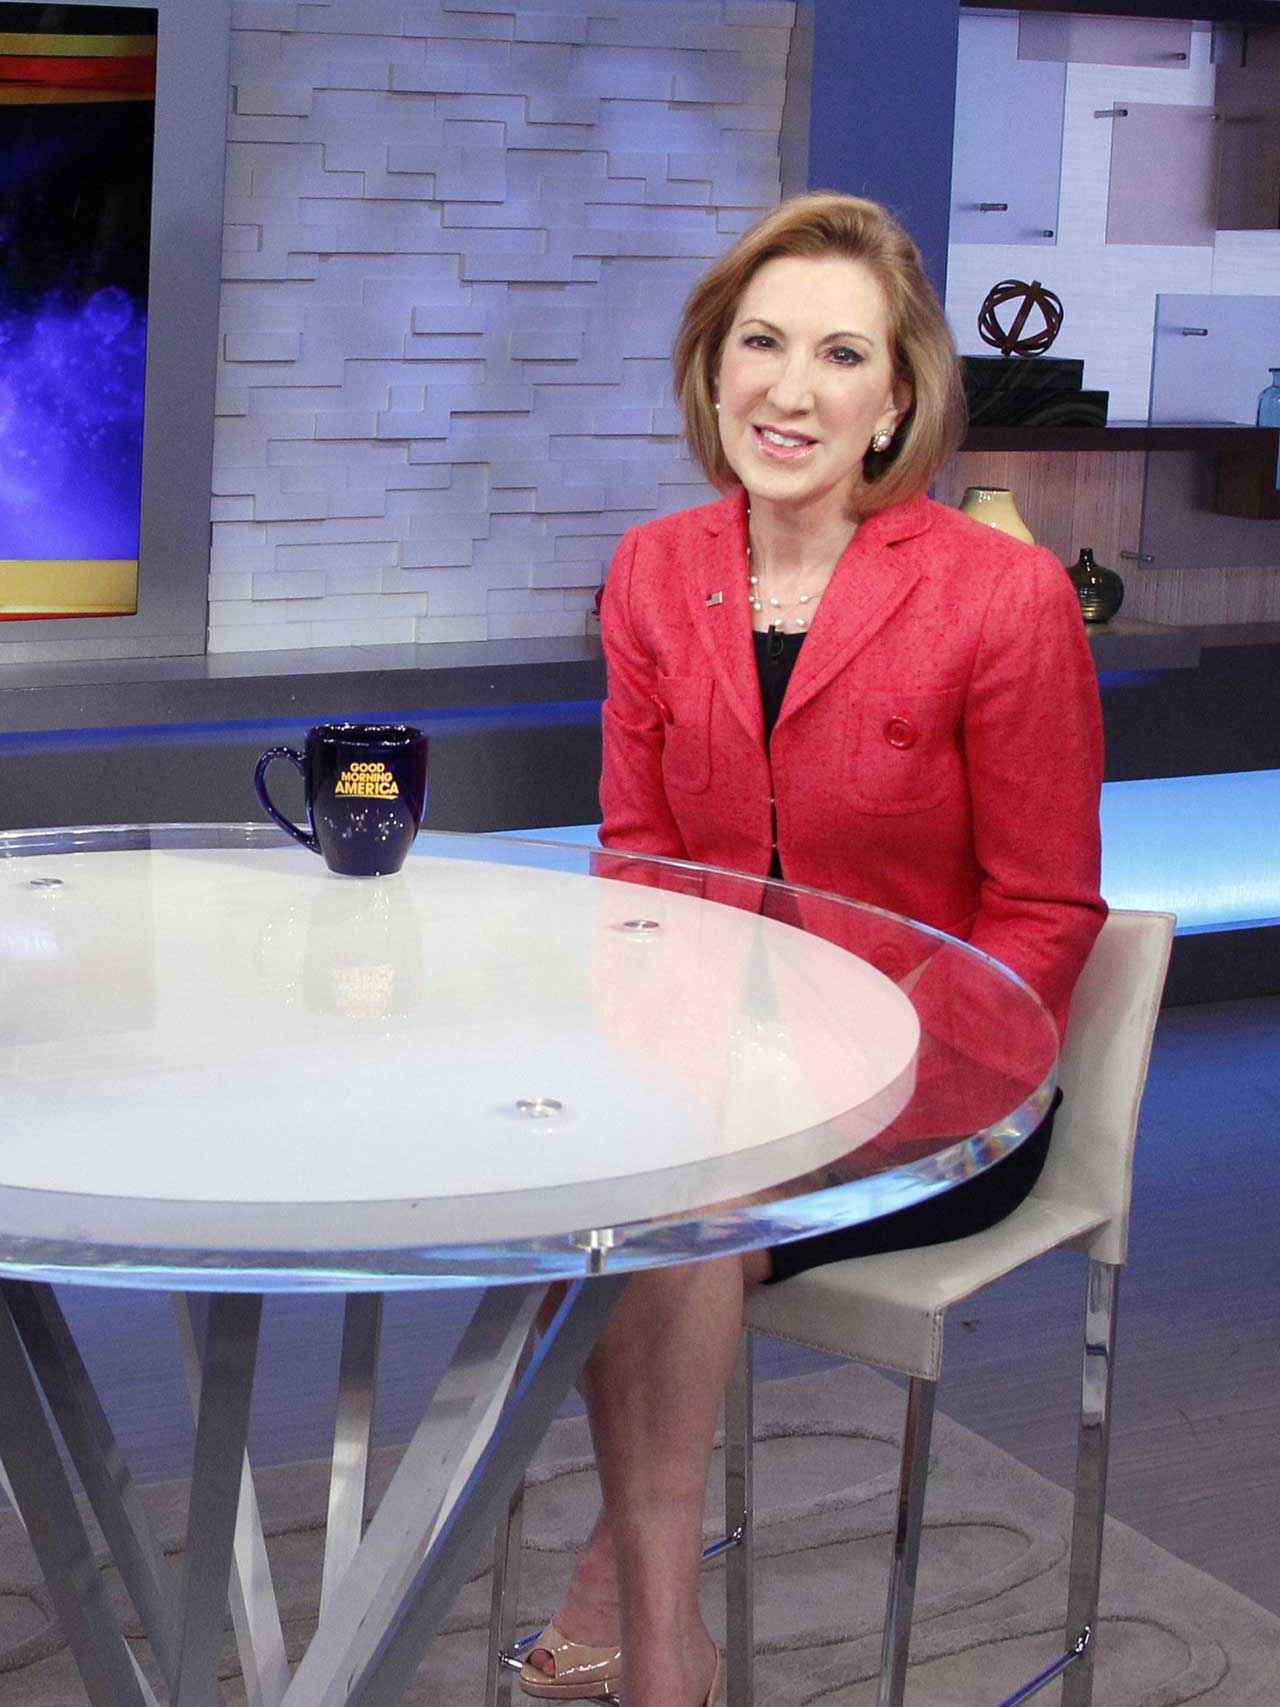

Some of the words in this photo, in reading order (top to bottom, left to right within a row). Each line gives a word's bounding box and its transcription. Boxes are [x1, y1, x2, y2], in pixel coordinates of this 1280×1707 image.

[350, 763, 385, 773] GOOD
[341, 772, 393, 782] MORNING
[335, 780, 399, 795] AMERICA
